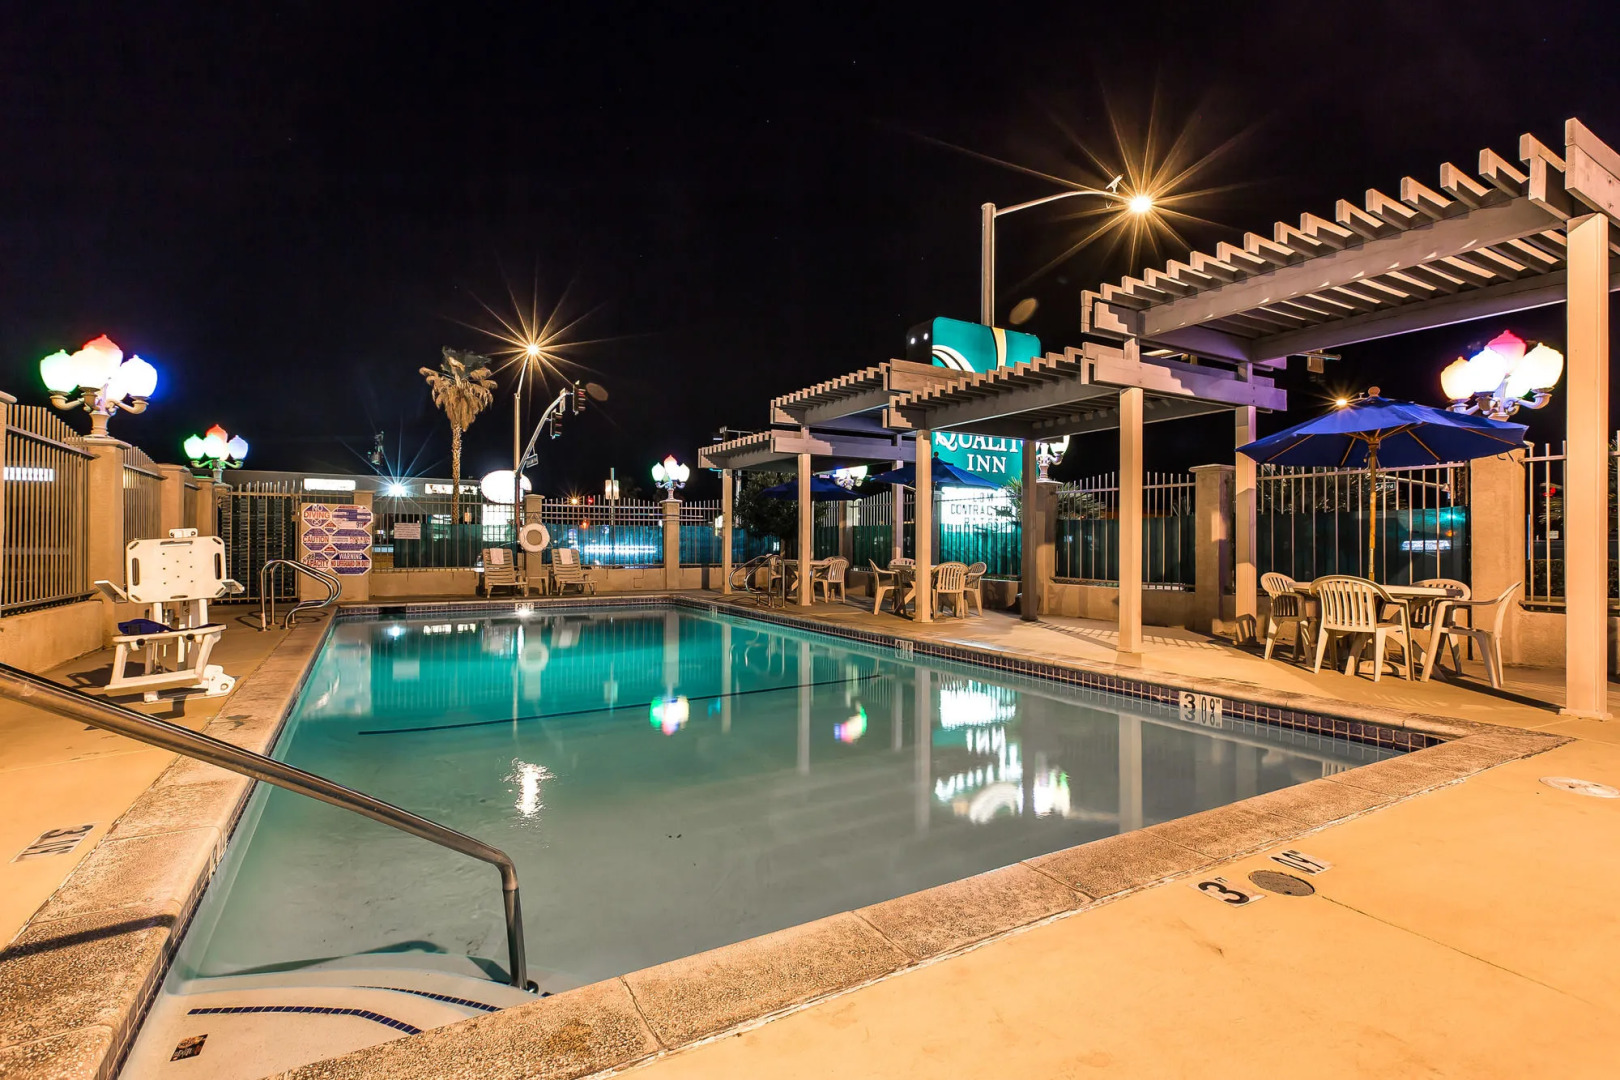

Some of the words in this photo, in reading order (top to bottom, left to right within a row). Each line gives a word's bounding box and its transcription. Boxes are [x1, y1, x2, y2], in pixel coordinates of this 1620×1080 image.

[935, 432, 1023, 453] QUALIT
[966, 454, 1006, 473] INN
[1197, 881, 1250, 905] 3
